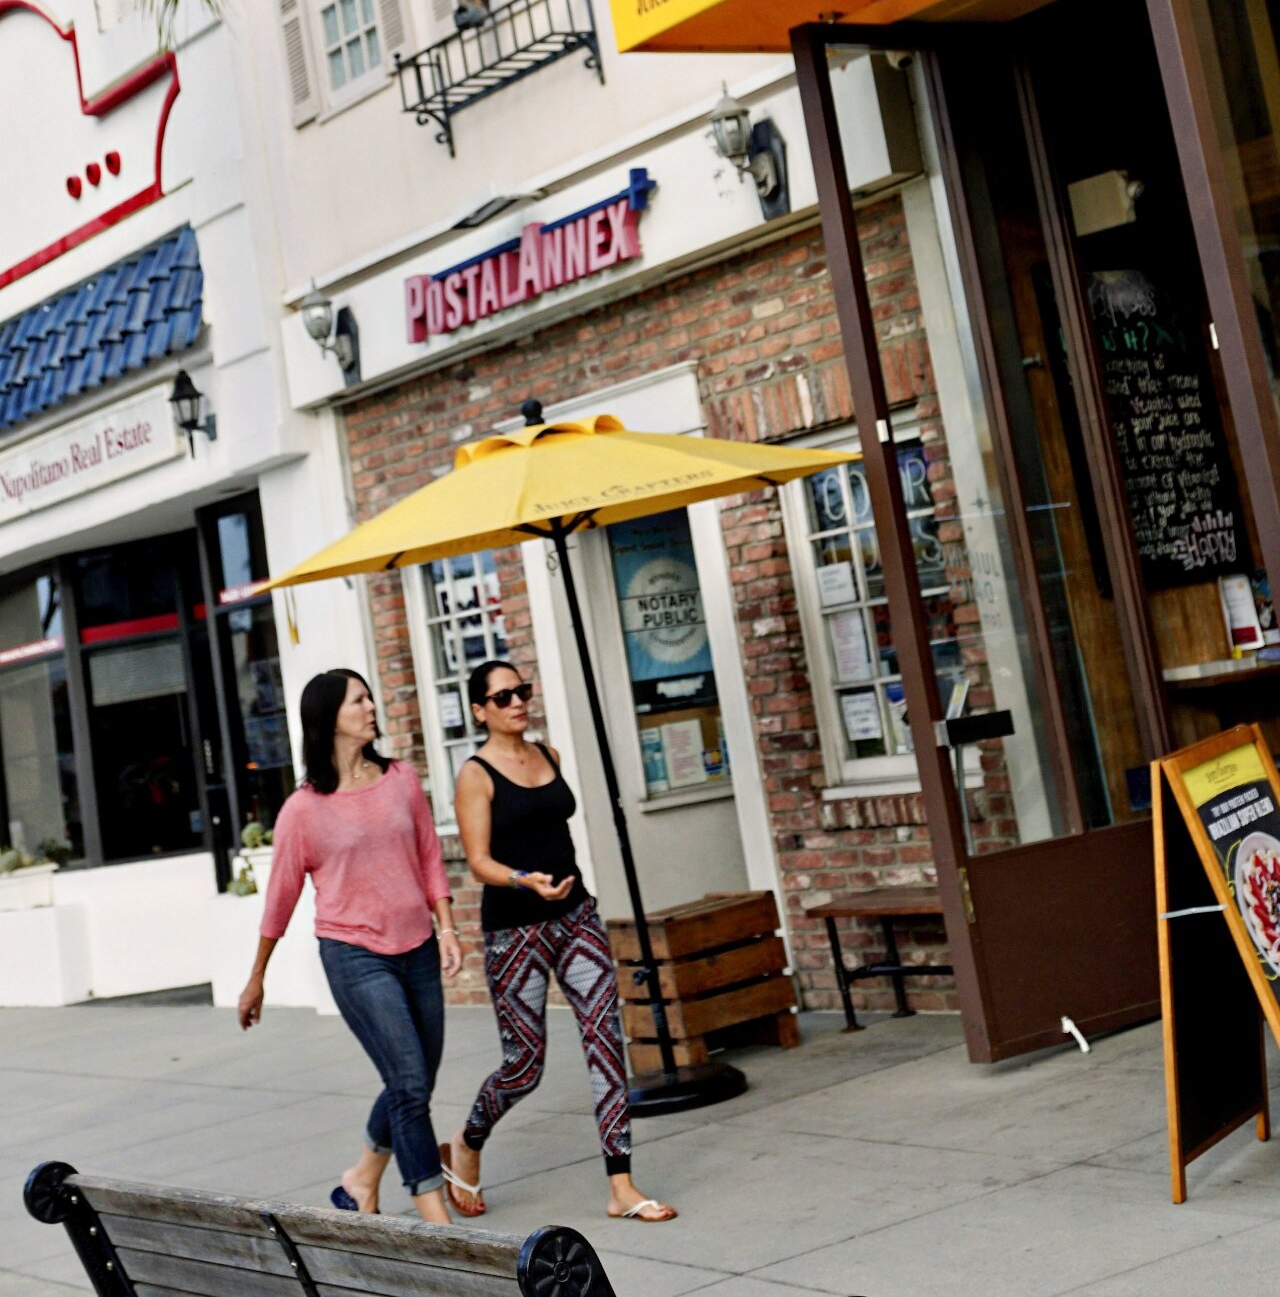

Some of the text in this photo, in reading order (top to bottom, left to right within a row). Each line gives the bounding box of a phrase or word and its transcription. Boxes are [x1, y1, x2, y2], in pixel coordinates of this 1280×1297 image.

[0, 456, 68, 504] Napolitano
[70, 435, 102, 474] Real
[104, 421, 153, 461] Estate
[601, 467, 715, 500] CRAFTERS
[638, 593, 698, 612] NOTARY
[643, 608, 698, 627] PUBLIC
